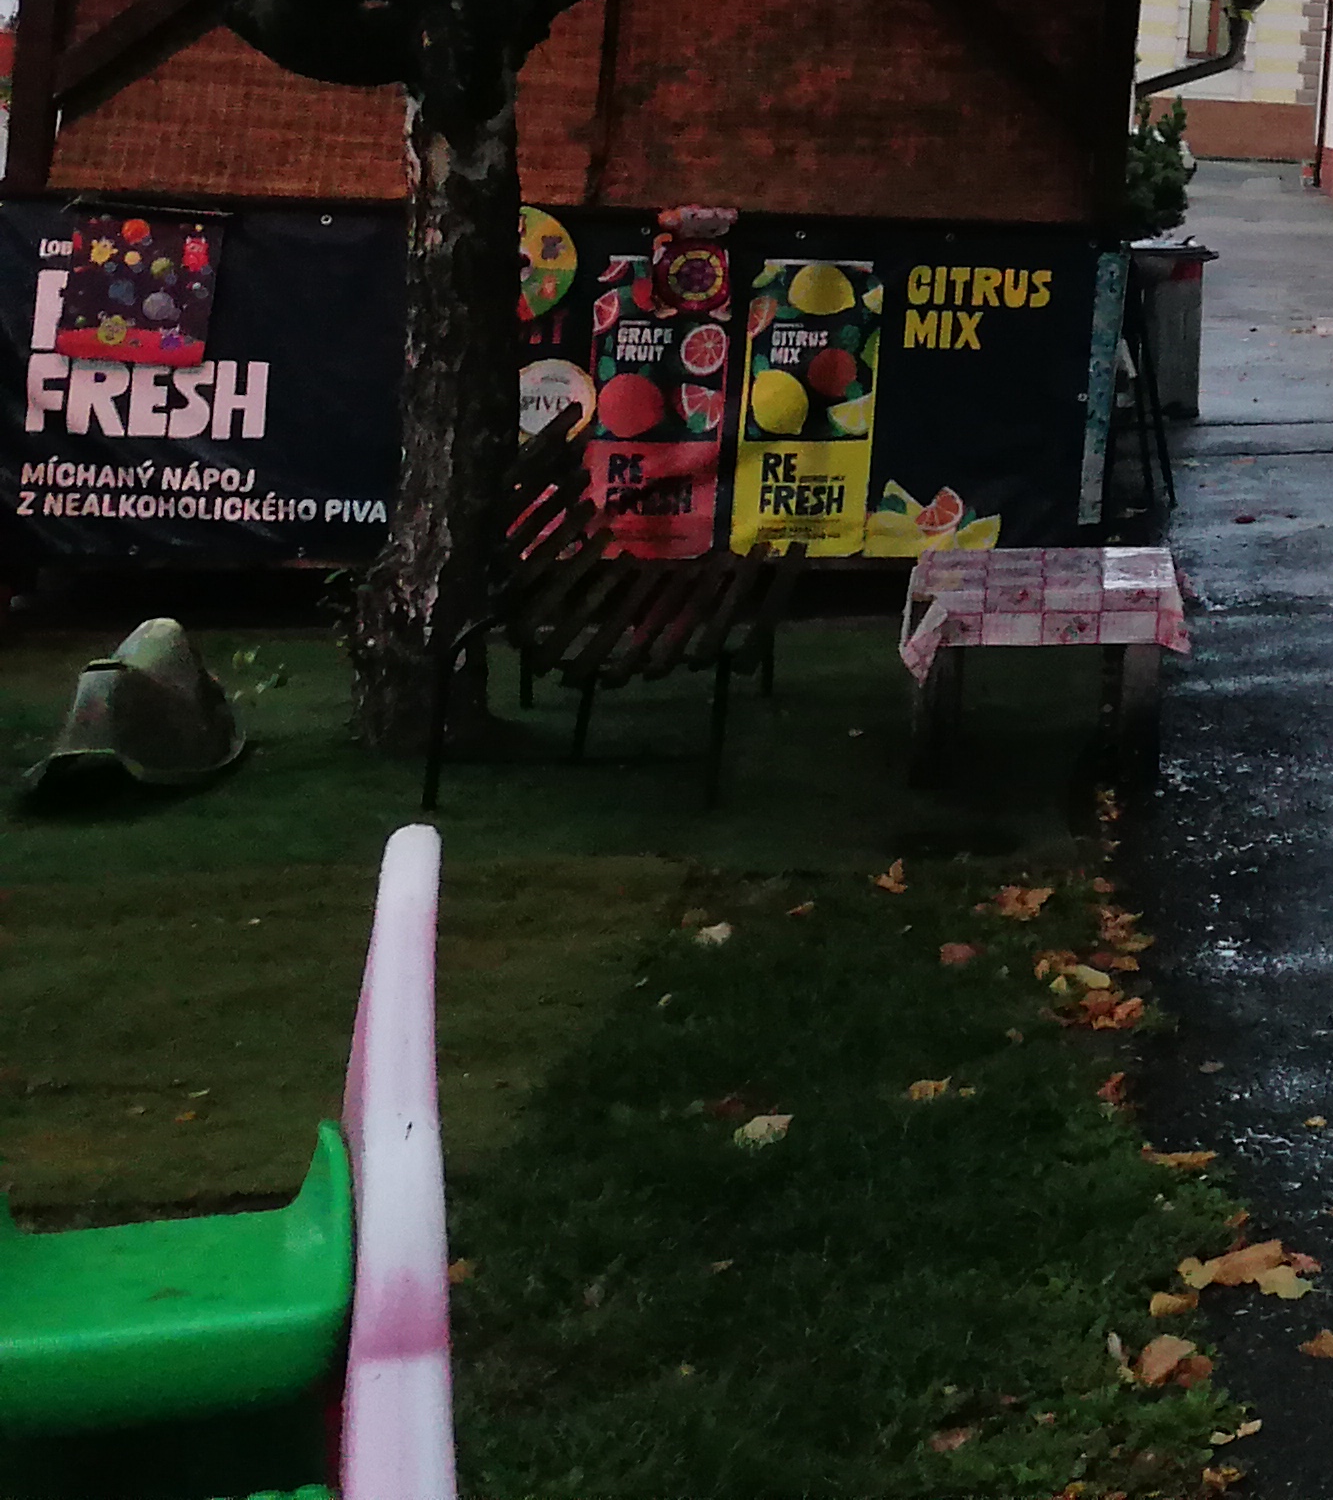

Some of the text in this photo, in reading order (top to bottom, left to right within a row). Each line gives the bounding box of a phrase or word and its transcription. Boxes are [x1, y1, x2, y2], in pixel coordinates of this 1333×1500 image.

[907, 265, 1053, 309] CITRUS
[617, 327, 674, 345] GRAPE
[771, 330, 829, 348] CITRUS
[903, 308, 984, 351] MIX
[616, 344, 665, 362] FRUIT
[770, 347, 801, 364] MIX
[25, 352, 270, 440] FRESH
[20, 455, 256, 493] MÍCHANÝ NÁPOJ
[762, 452, 798, 483] RE
[16, 491, 388, 524] Z NEALKOHOLICKÉHO PIVA
[759, 484, 846, 516] FRESH
